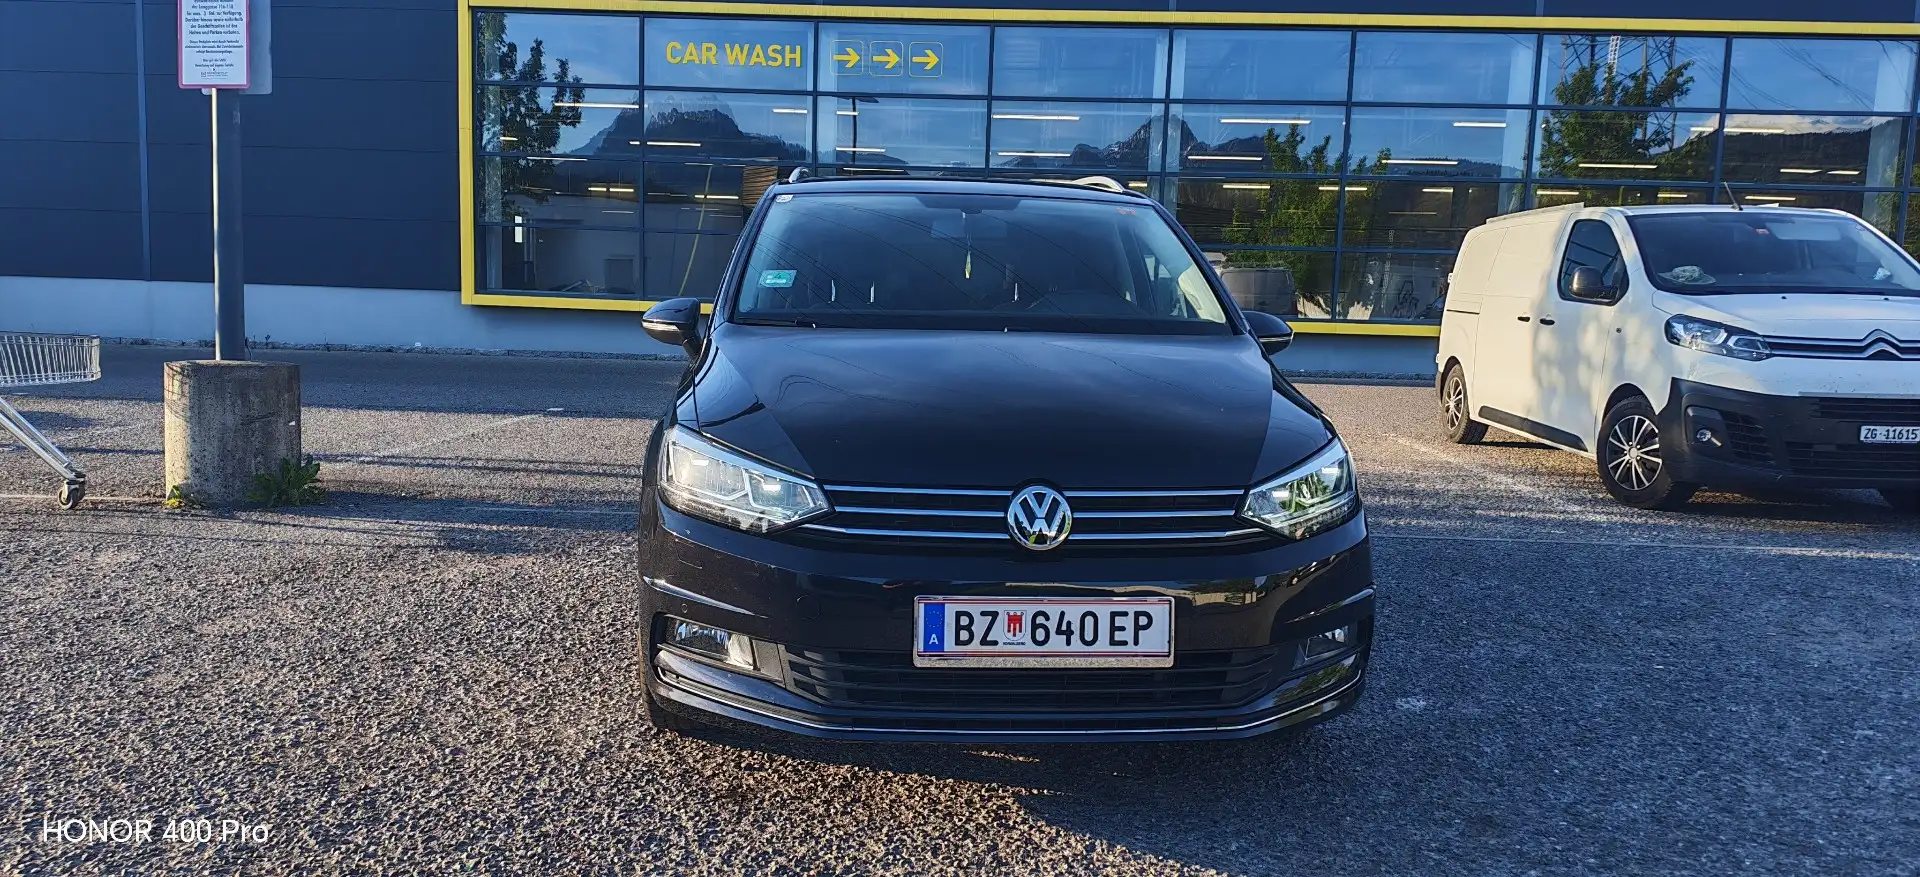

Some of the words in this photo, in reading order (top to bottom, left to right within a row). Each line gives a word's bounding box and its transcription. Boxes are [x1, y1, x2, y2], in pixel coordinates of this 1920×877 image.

[666, 41, 718, 65] CAR
[724, 43, 801, 67] WASH
[929, 634, 939, 645] A
[954, 610, 999, 647] BZ
[1030, 610, 1099, 647] 640
[1109, 610, 1154, 647] EP
